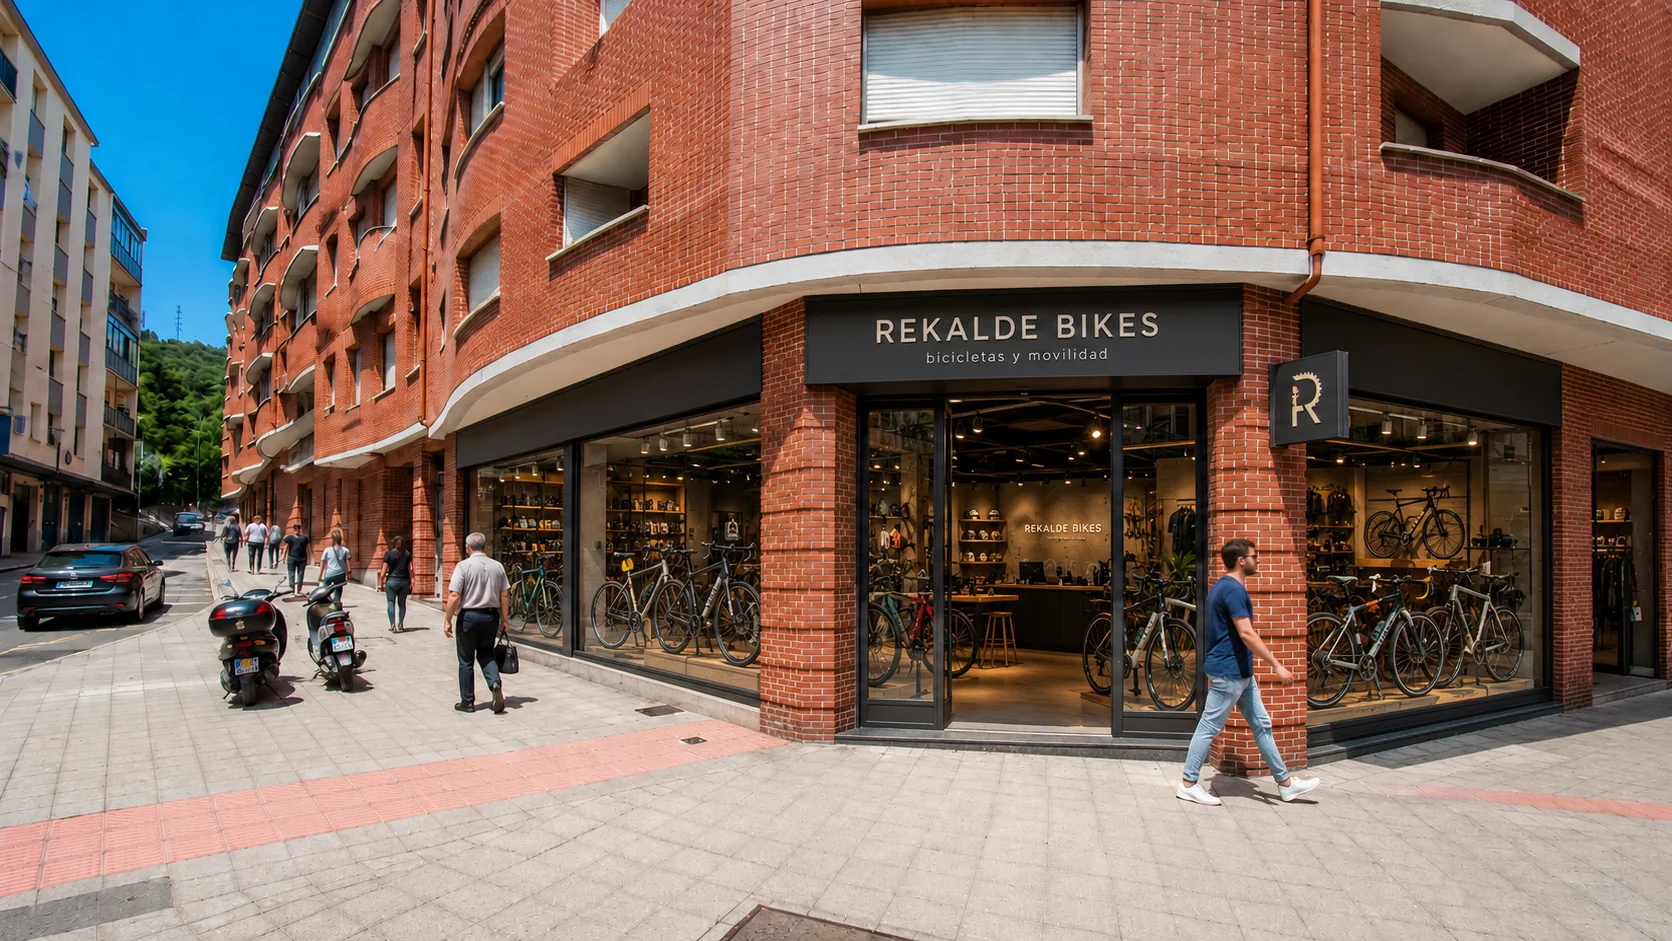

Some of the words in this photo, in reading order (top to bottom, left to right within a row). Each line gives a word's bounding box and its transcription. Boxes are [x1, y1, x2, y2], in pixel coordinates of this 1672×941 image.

[875, 314, 1038, 344] REKALDE
[1056, 311, 1160, 340] BIKES
[926, 350, 1006, 364] bicicletas
[1012, 351, 1021, 364] y
[1028, 348, 1108, 362] movilidad
[1291, 371, 1323, 428] R
[1024, 523, 1069, 533] REKALDE
[1072, 523, 1102, 533] BIKES
